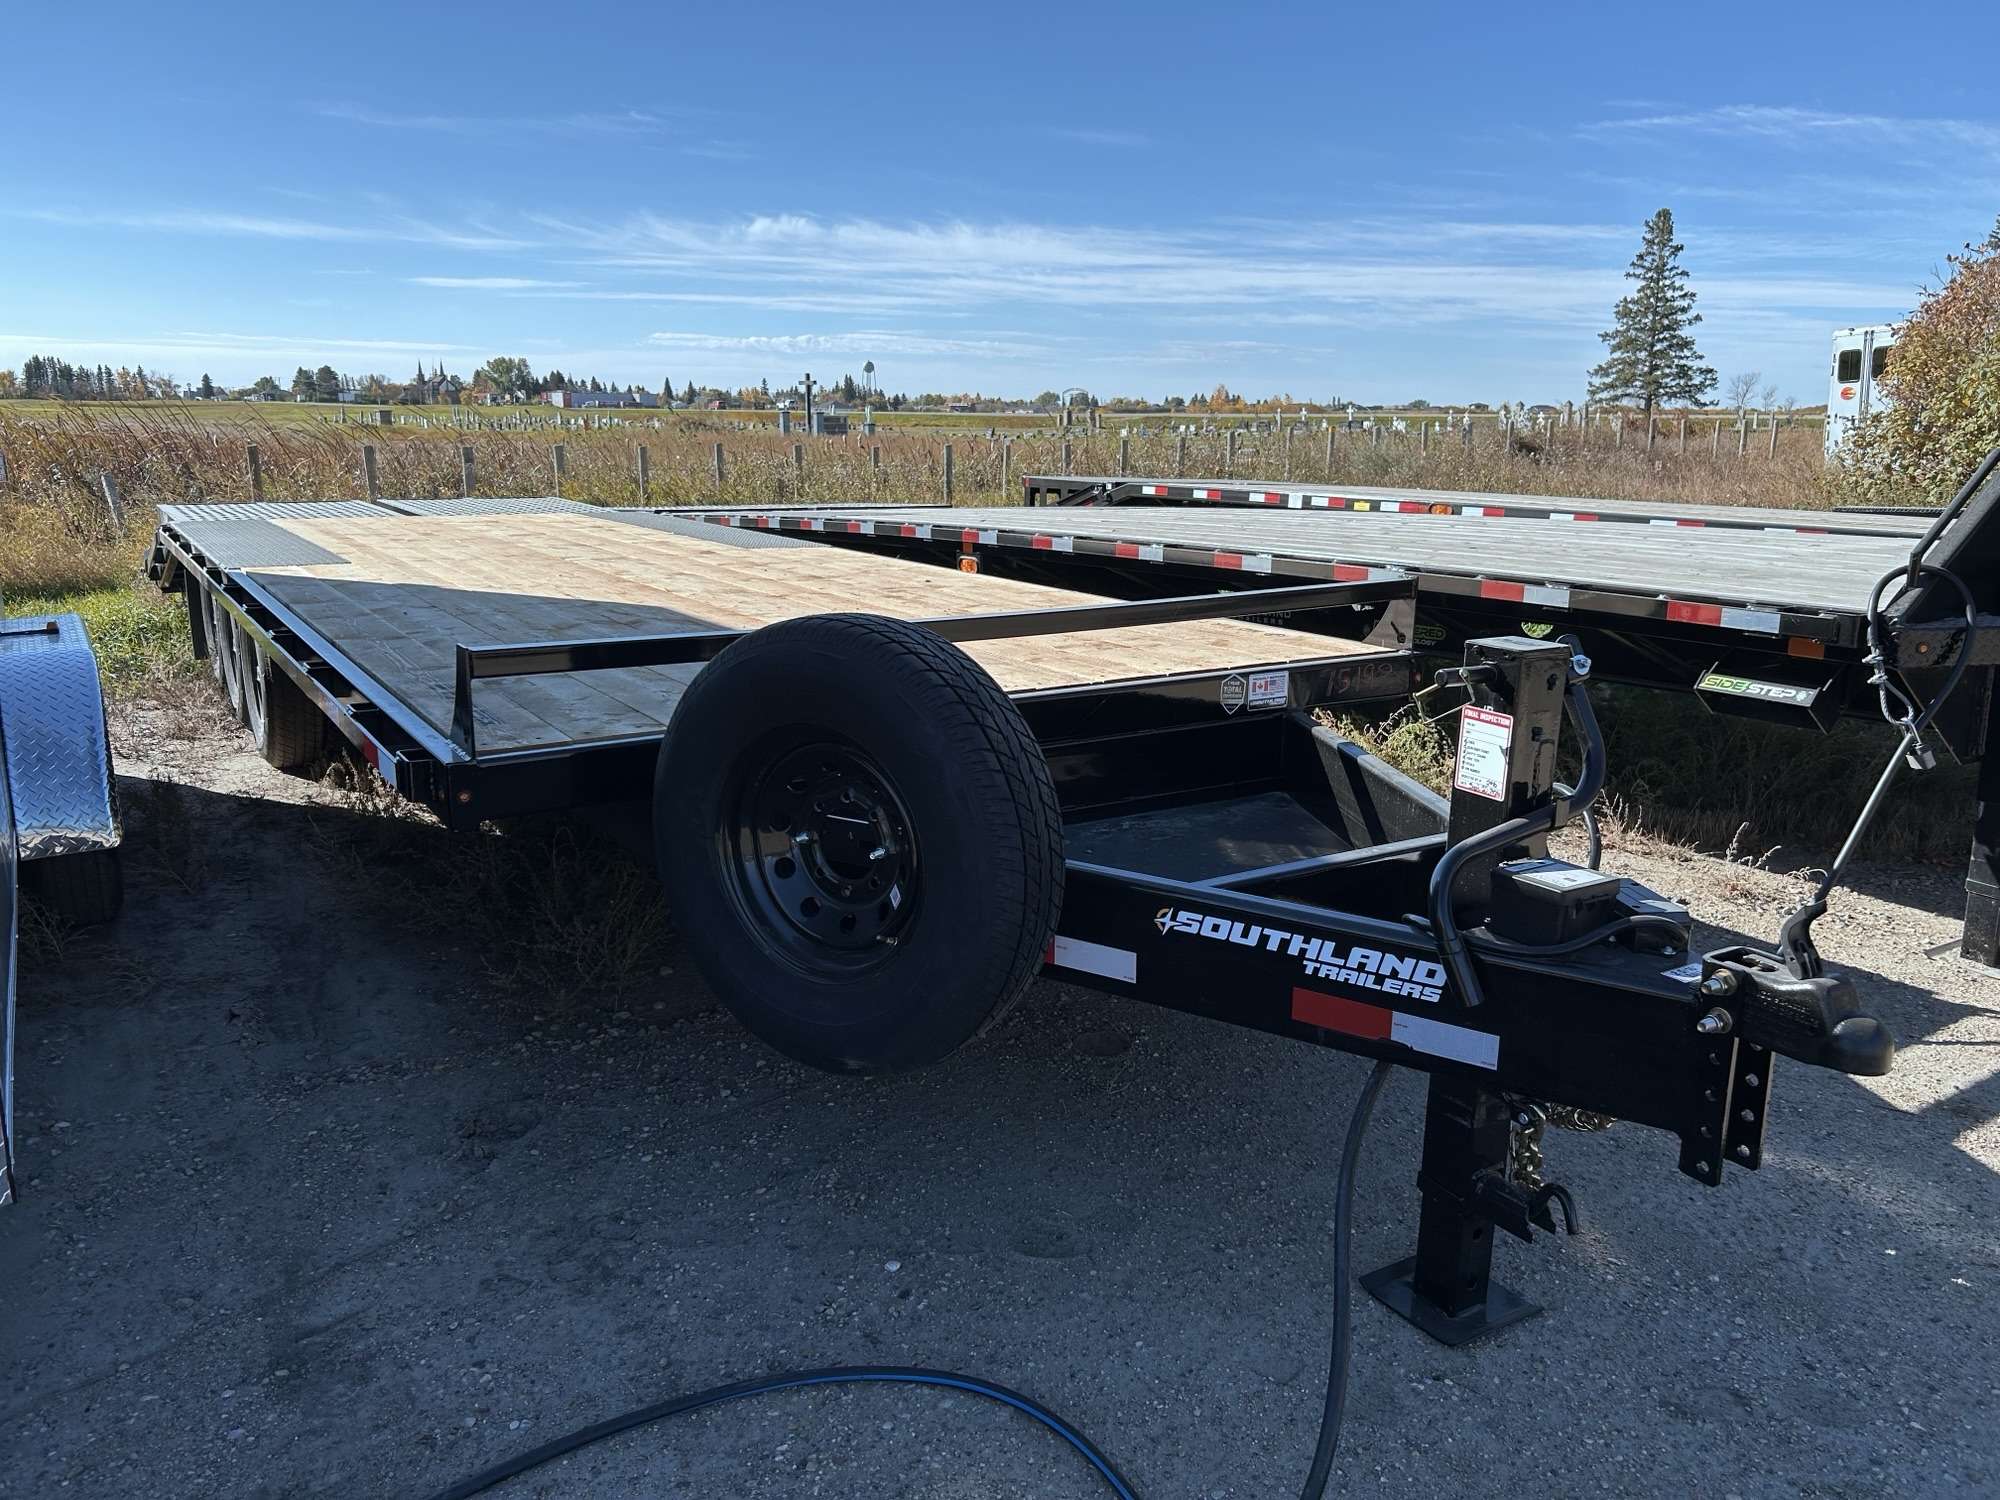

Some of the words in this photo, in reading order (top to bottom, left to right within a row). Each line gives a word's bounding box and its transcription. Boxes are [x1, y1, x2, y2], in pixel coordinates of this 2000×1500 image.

[1223, 685, 1243, 694] TOTAL
[1465, 709, 1479, 719] FINAL
[1479, 712, 1511, 727] INSPECTION
[1174, 910, 1448, 987] SOUTHLAND
[1302, 960, 1443, 1003] TRAILERS
